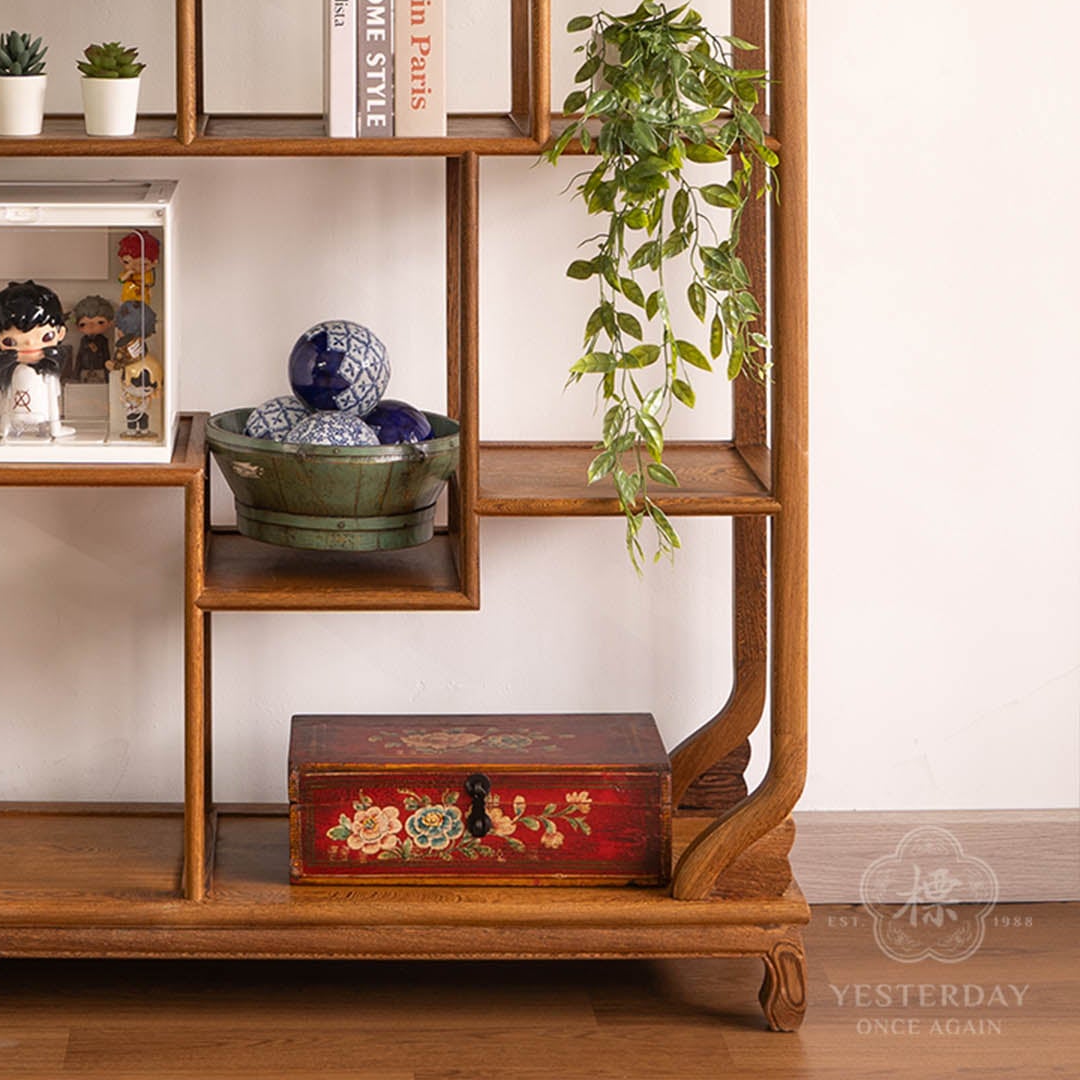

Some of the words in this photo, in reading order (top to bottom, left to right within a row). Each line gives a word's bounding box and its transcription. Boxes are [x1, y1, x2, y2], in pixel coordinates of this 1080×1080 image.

[410, 0, 431, 26] in
[366, 52, 386, 128] STYLE
[410, 35, 432, 111] Paris
